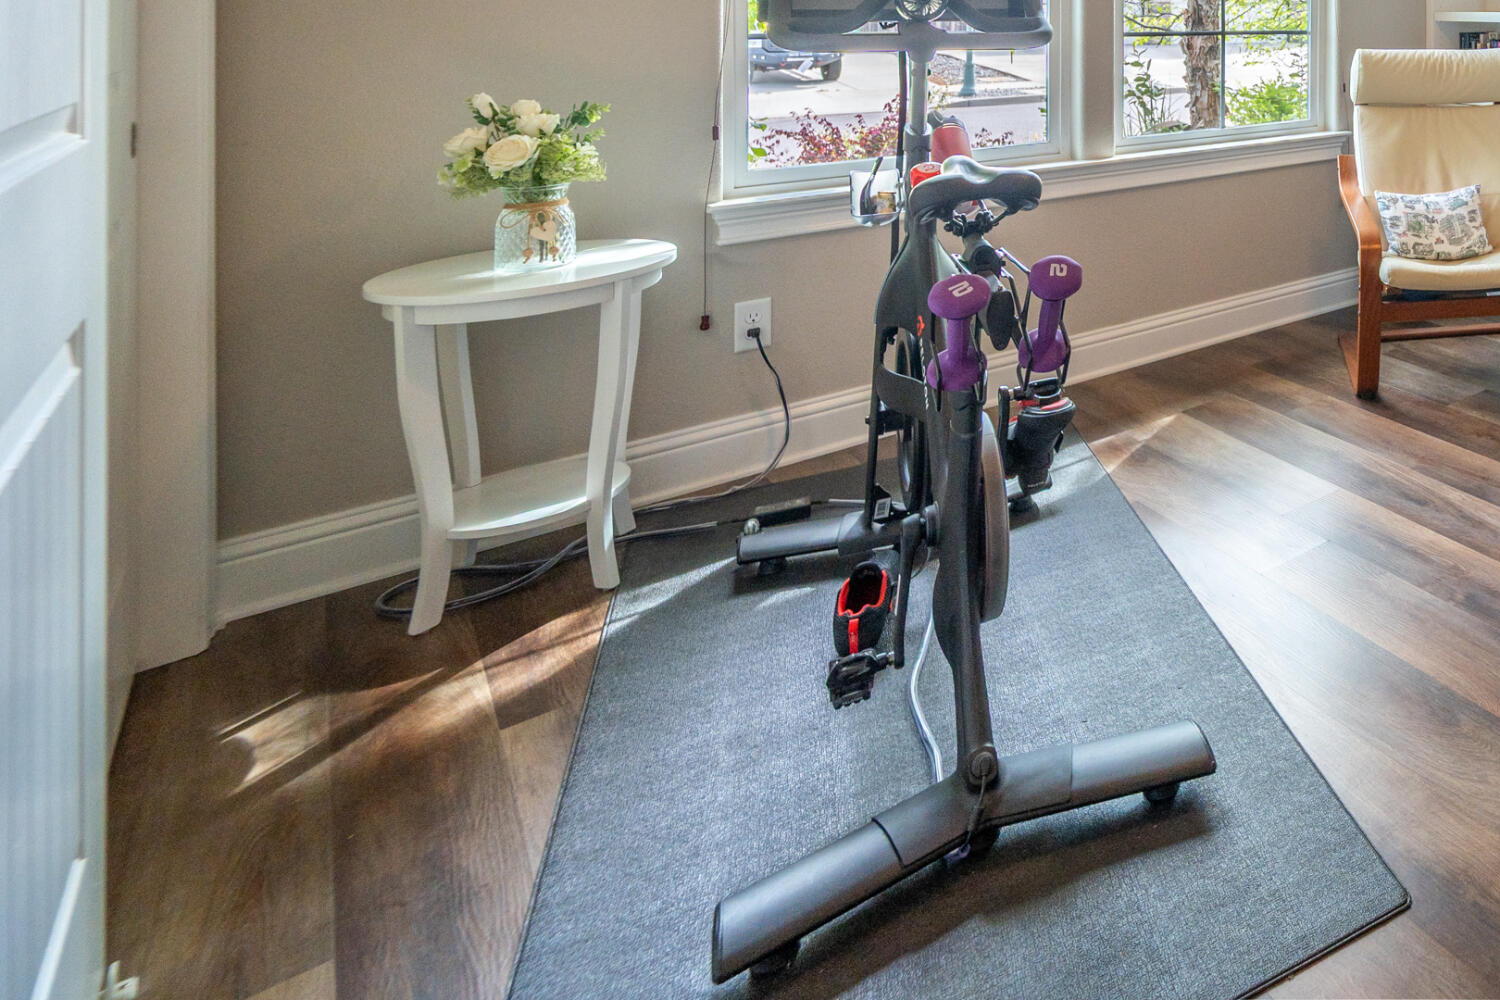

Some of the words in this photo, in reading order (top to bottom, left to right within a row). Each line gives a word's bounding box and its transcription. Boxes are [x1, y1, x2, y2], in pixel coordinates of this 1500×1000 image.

[1049, 263, 1068, 277] 2
[948, 280, 974, 298] 2
[919, 337, 929, 411] PELOTON
